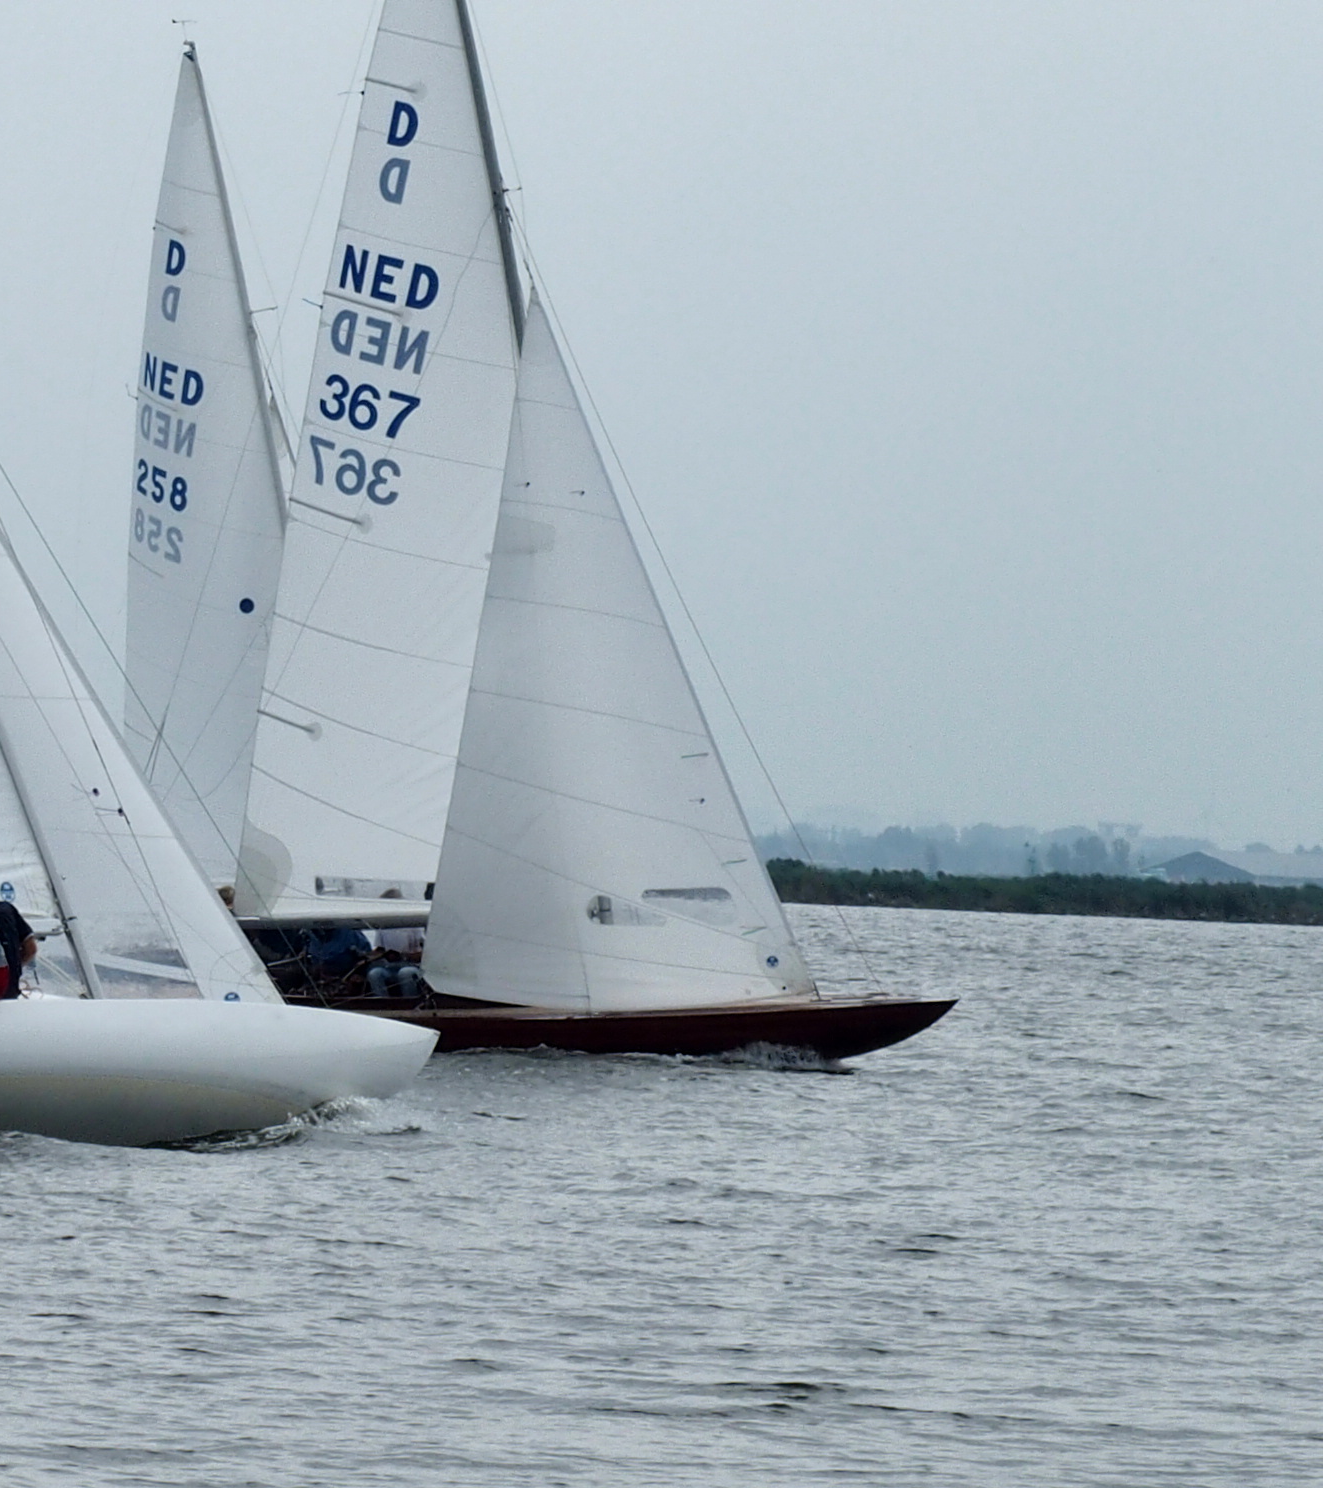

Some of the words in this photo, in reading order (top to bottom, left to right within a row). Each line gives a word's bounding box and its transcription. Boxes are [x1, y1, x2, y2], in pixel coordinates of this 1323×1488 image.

[387, 101, 418, 146] D
[166, 240, 185, 276] D
[340, 245, 438, 309] NED
[144, 353, 203, 405] NED
[320, 374, 420, 438] 367
[137, 459, 187, 512] 258
